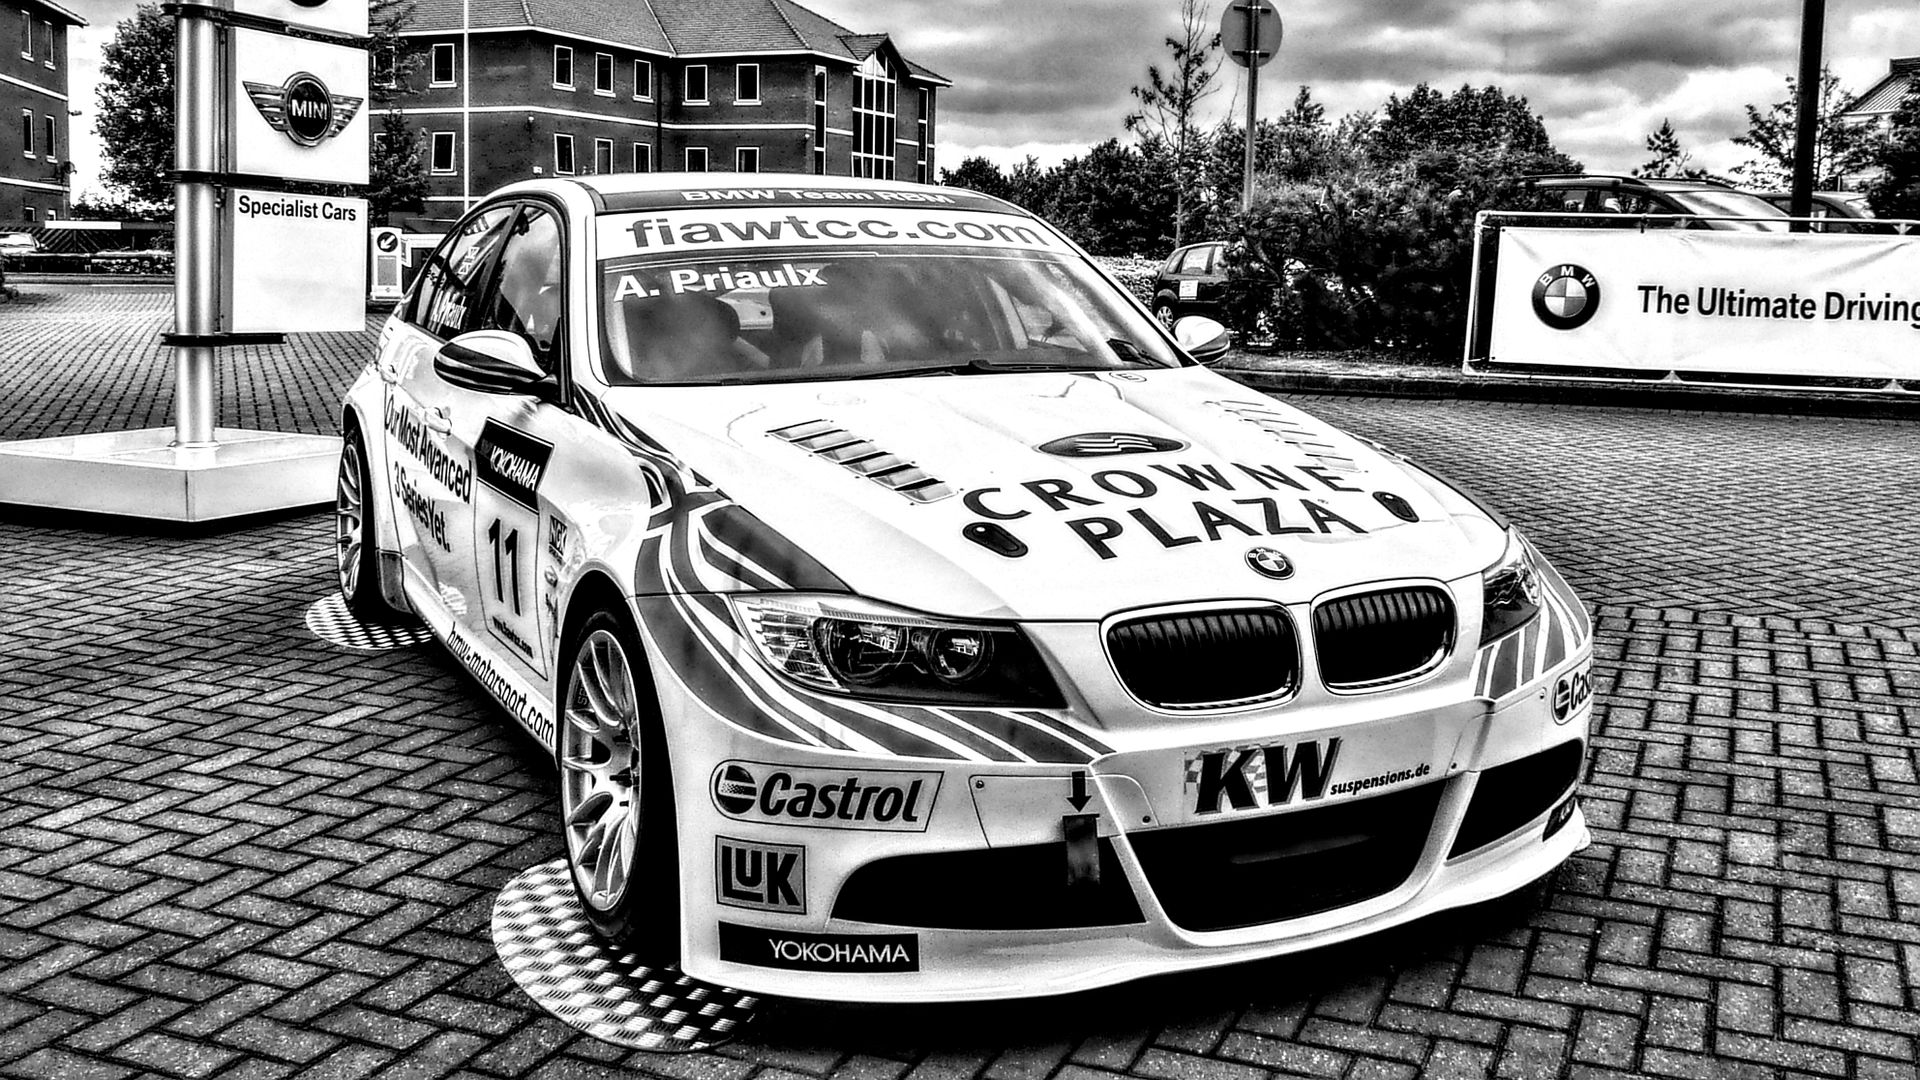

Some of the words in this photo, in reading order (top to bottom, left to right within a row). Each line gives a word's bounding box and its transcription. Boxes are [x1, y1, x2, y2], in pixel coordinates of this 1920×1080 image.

[291, 99, 328, 121] MINI
[238, 195, 319, 219] Specialist
[321, 202, 357, 222] Cars
[681, 189, 776, 201] BMW
[778, 189, 875, 201] Team
[873, 190, 956, 204] RBM
[626, 214, 1051, 249] fiawtcc.com
[613, 274, 661, 303] A.
[669, 263, 828, 294] Priaulx
[1538, 265, 1596, 288] BMW
[1638, 285, 1690, 315] The
[1698, 286, 1817, 320] Ultimate
[384, 393, 400, 438] Our
[398, 405, 421, 459] Most
[419, 424, 472, 504] Advanced
[490, 445, 540, 491] YOKOHAMA
[394, 460, 401, 498] 3
[401, 466, 429, 529] Series
[962, 461, 1365, 521] CROWNE
[1064, 496, 1370, 560] PLAZA
[488, 518, 522, 617] 11
[446, 621, 554, 748] bmw-motorsport.com
[759, 772, 923, 823] Castrol
[1195, 737, 1342, 815] KW
[1330, 762, 1430, 796] suspensions.de
[768, 938, 911, 963] YOKOHAMA
